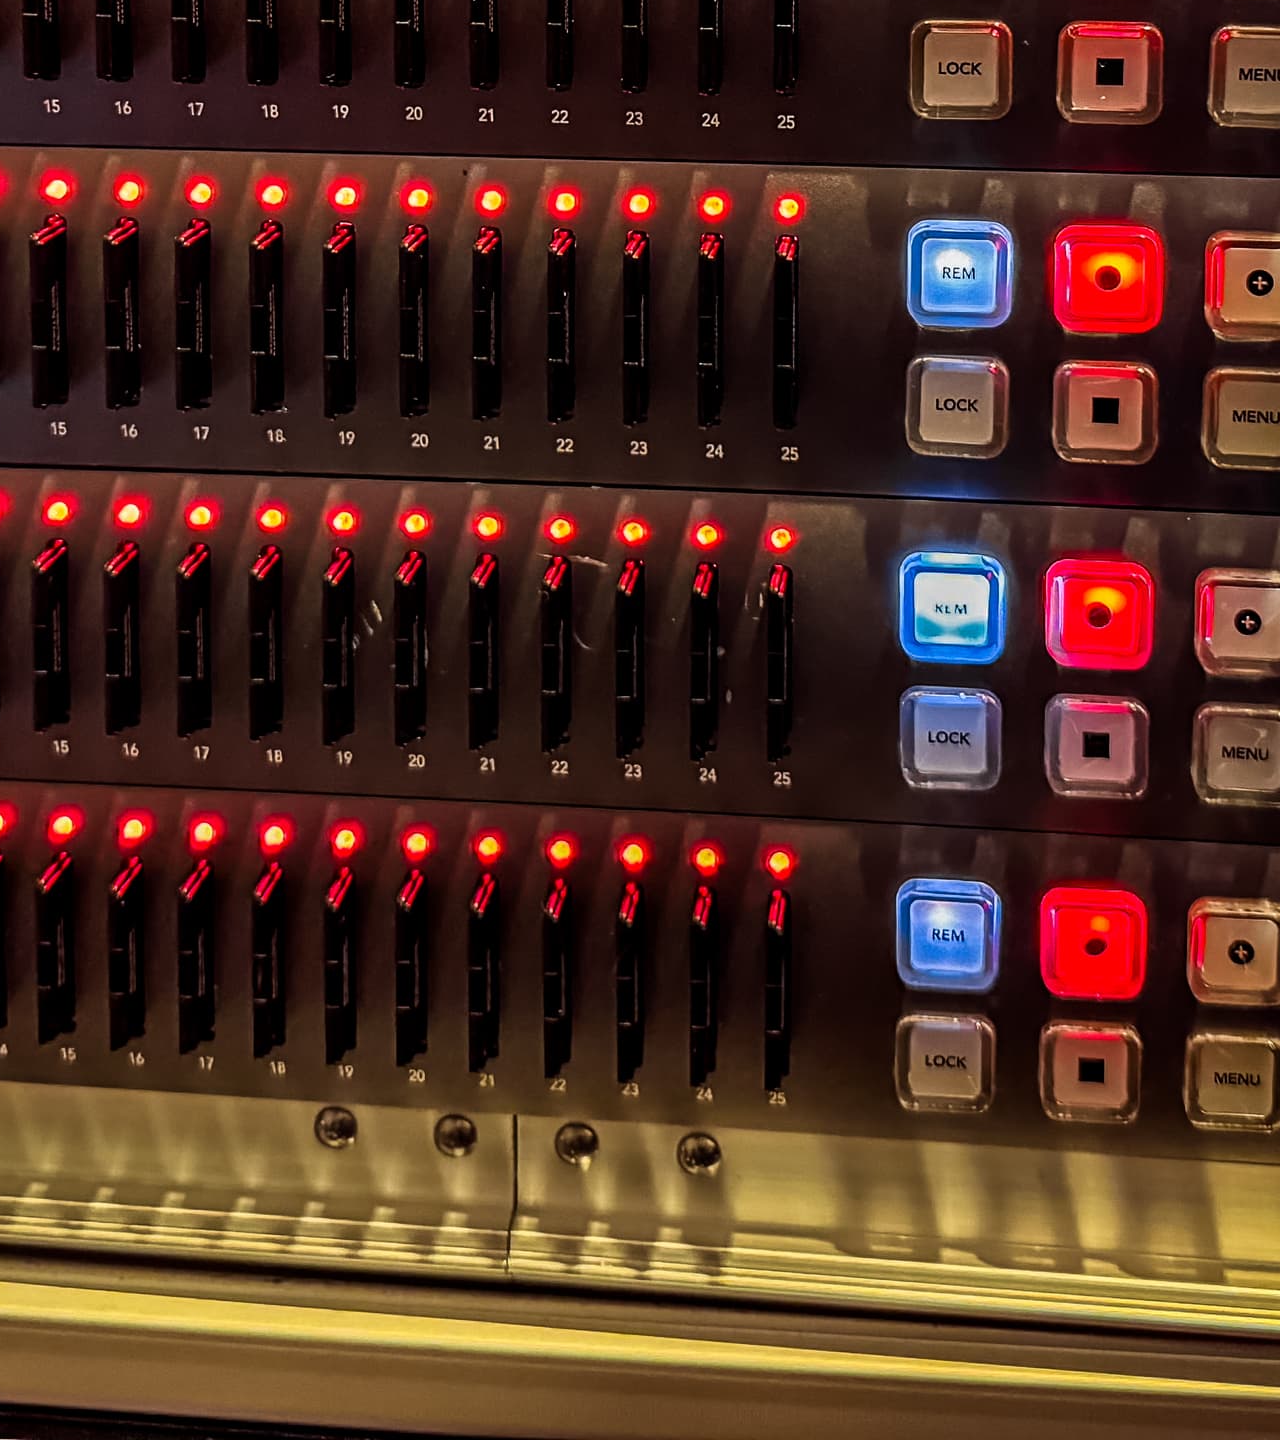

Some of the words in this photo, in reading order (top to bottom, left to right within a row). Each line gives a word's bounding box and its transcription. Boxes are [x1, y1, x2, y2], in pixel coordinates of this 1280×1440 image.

[938, 61, 983, 76] LOCK
[43, 99, 61, 113] 15
[114, 100, 132, 115] 16
[187, 102, 204, 116] 17
[261, 104, 279, 119] 18
[332, 104, 349, 119] 19
[405, 106, 423, 121] 20
[478, 107, 494, 123] 21
[551, 109, 569, 124] 22
[625, 111, 644, 126] 23
[701, 112, 721, 128] 24
[777, 114, 796, 130] 25
[941, 264, 978, 282] REM
[935, 398, 979, 413] LOCK
[1232, 409, 1280, 425] MENU
[267, 428, 287, 443] 18
[338, 431, 356, 446] 19
[411, 433, 429, 448] 20
[483, 435, 500, 450] 21
[556, 438, 574, 453] 22
[630, 440, 648, 456] 23
[705, 443, 724, 459] 24
[781, 446, 800, 461] 25
[928, 730, 971, 747] LOCK
[408, 753, 426, 768] 20
[1221, 746, 1270, 762] MENU
[479, 756, 496, 772] 21
[551, 760, 569, 775] 22
[624, 763, 642, 779] 23
[699, 767, 717, 783] 24
[773, 771, 792, 786] 25
[932, 928, 965, 943] REM
[925, 1054, 967, 1070] LOCK
[408, 1069, 426, 1083] 20
[479, 1073, 495, 1088] 21
[1214, 1071, 1261, 1087] MENU
[696, 1087, 713, 1102] 24
[769, 1092, 787, 1106] 25
